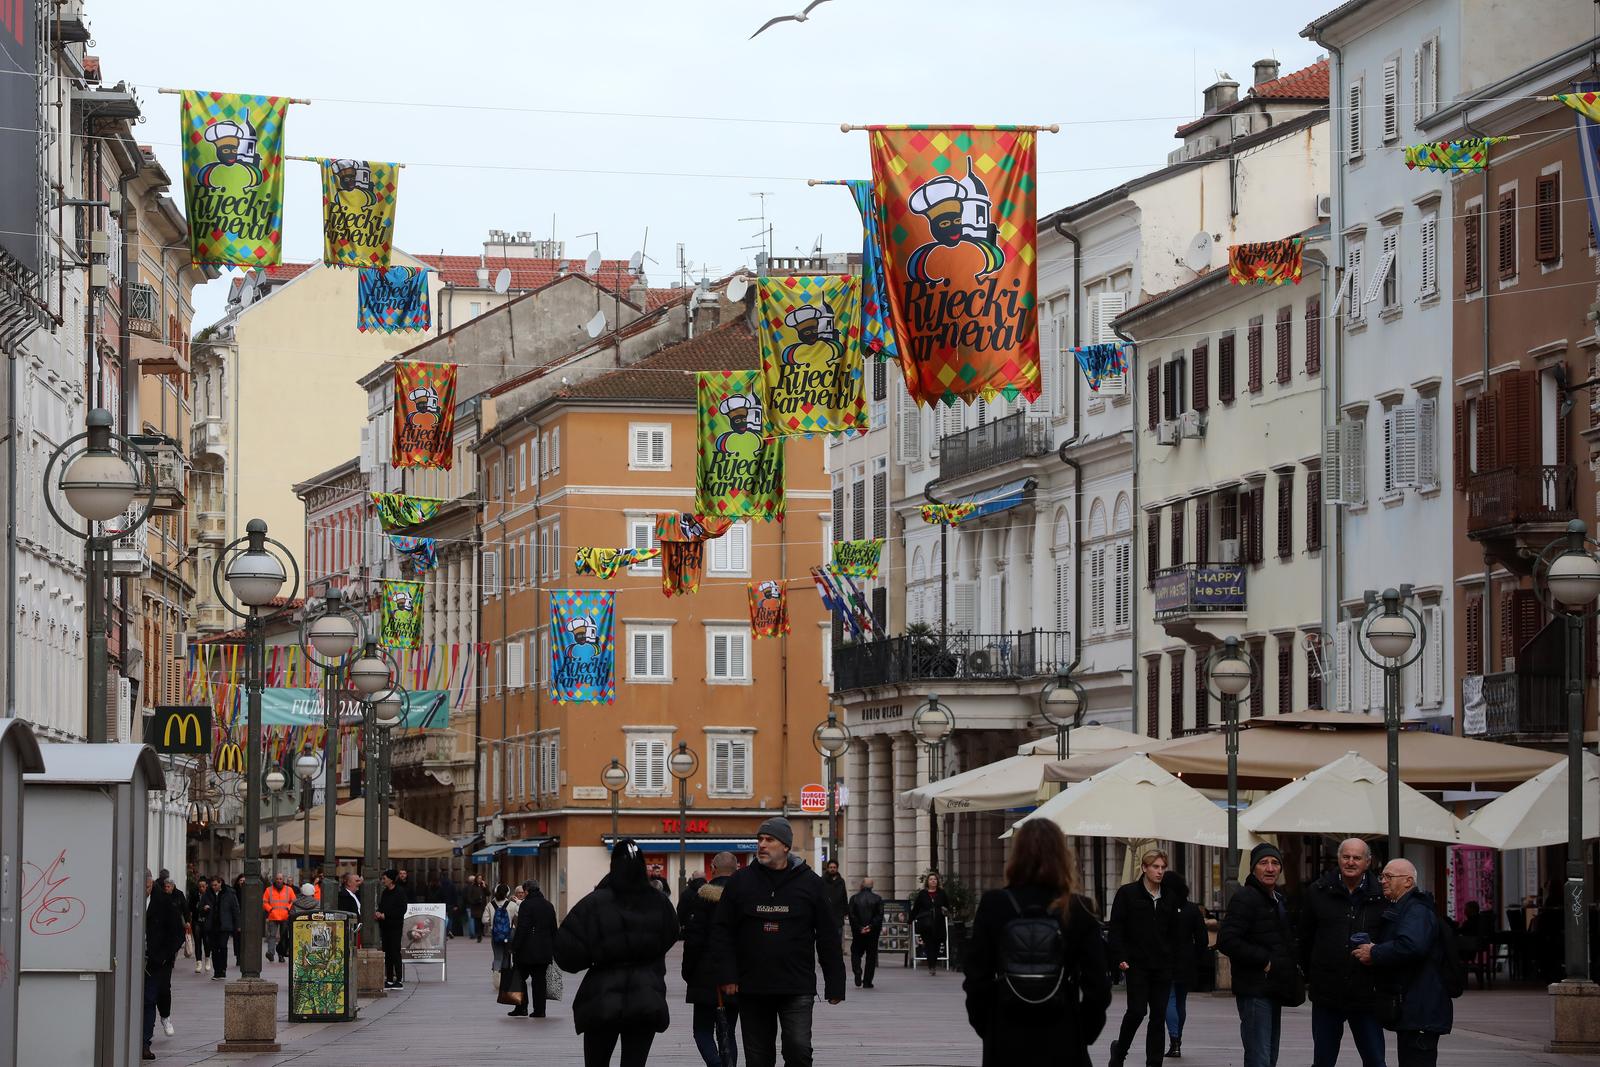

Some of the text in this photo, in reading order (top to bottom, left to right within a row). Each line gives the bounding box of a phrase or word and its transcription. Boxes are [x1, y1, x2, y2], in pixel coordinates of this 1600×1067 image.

[192, 211, 274, 241] arneval
[909, 307, 1028, 362] arneval
[769, 379, 856, 414] karneval
[703, 469, 779, 497] karneval
[1195, 586, 1245, 596] HOSTEL
[1197, 572, 1241, 582] HAPPY
[802, 799, 826, 807] KING
